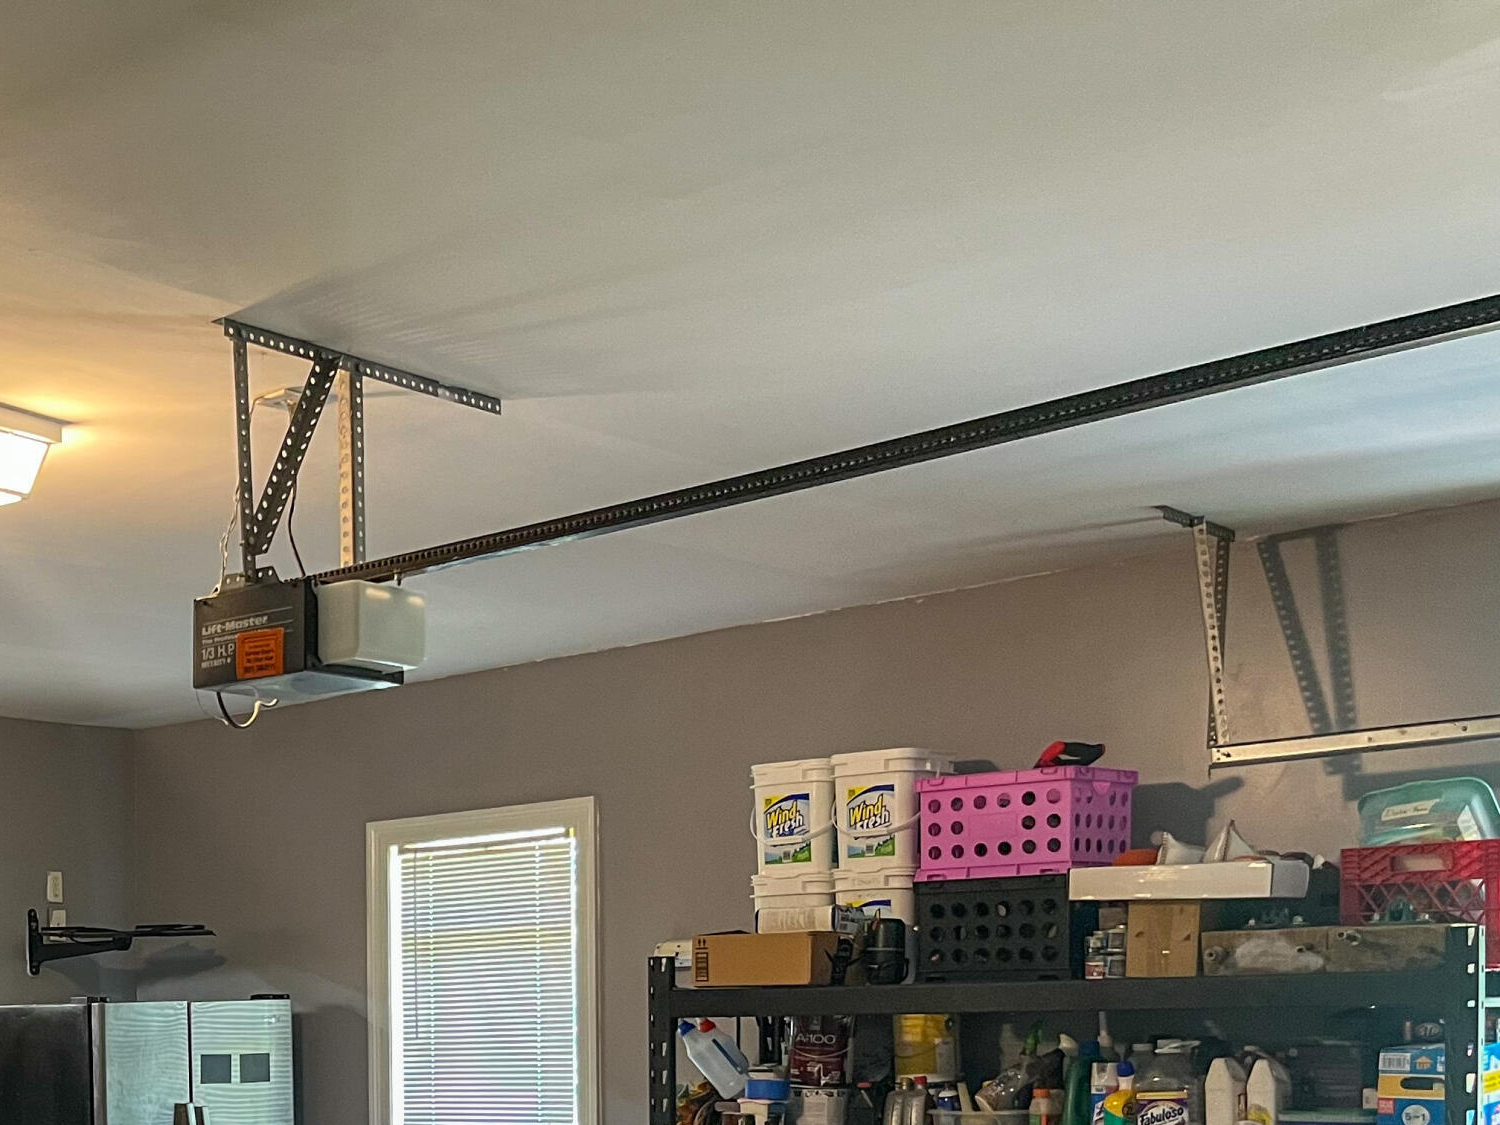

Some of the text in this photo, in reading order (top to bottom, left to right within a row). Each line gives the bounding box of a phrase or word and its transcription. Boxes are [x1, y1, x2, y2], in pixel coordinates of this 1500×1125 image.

[766, 800, 798, 829] Wind
[850, 794, 884, 826] Wind
[855, 809, 891, 831] Fresh
[770, 812, 804, 839] Fresh
[796, 1033, 836, 1045] A-100
